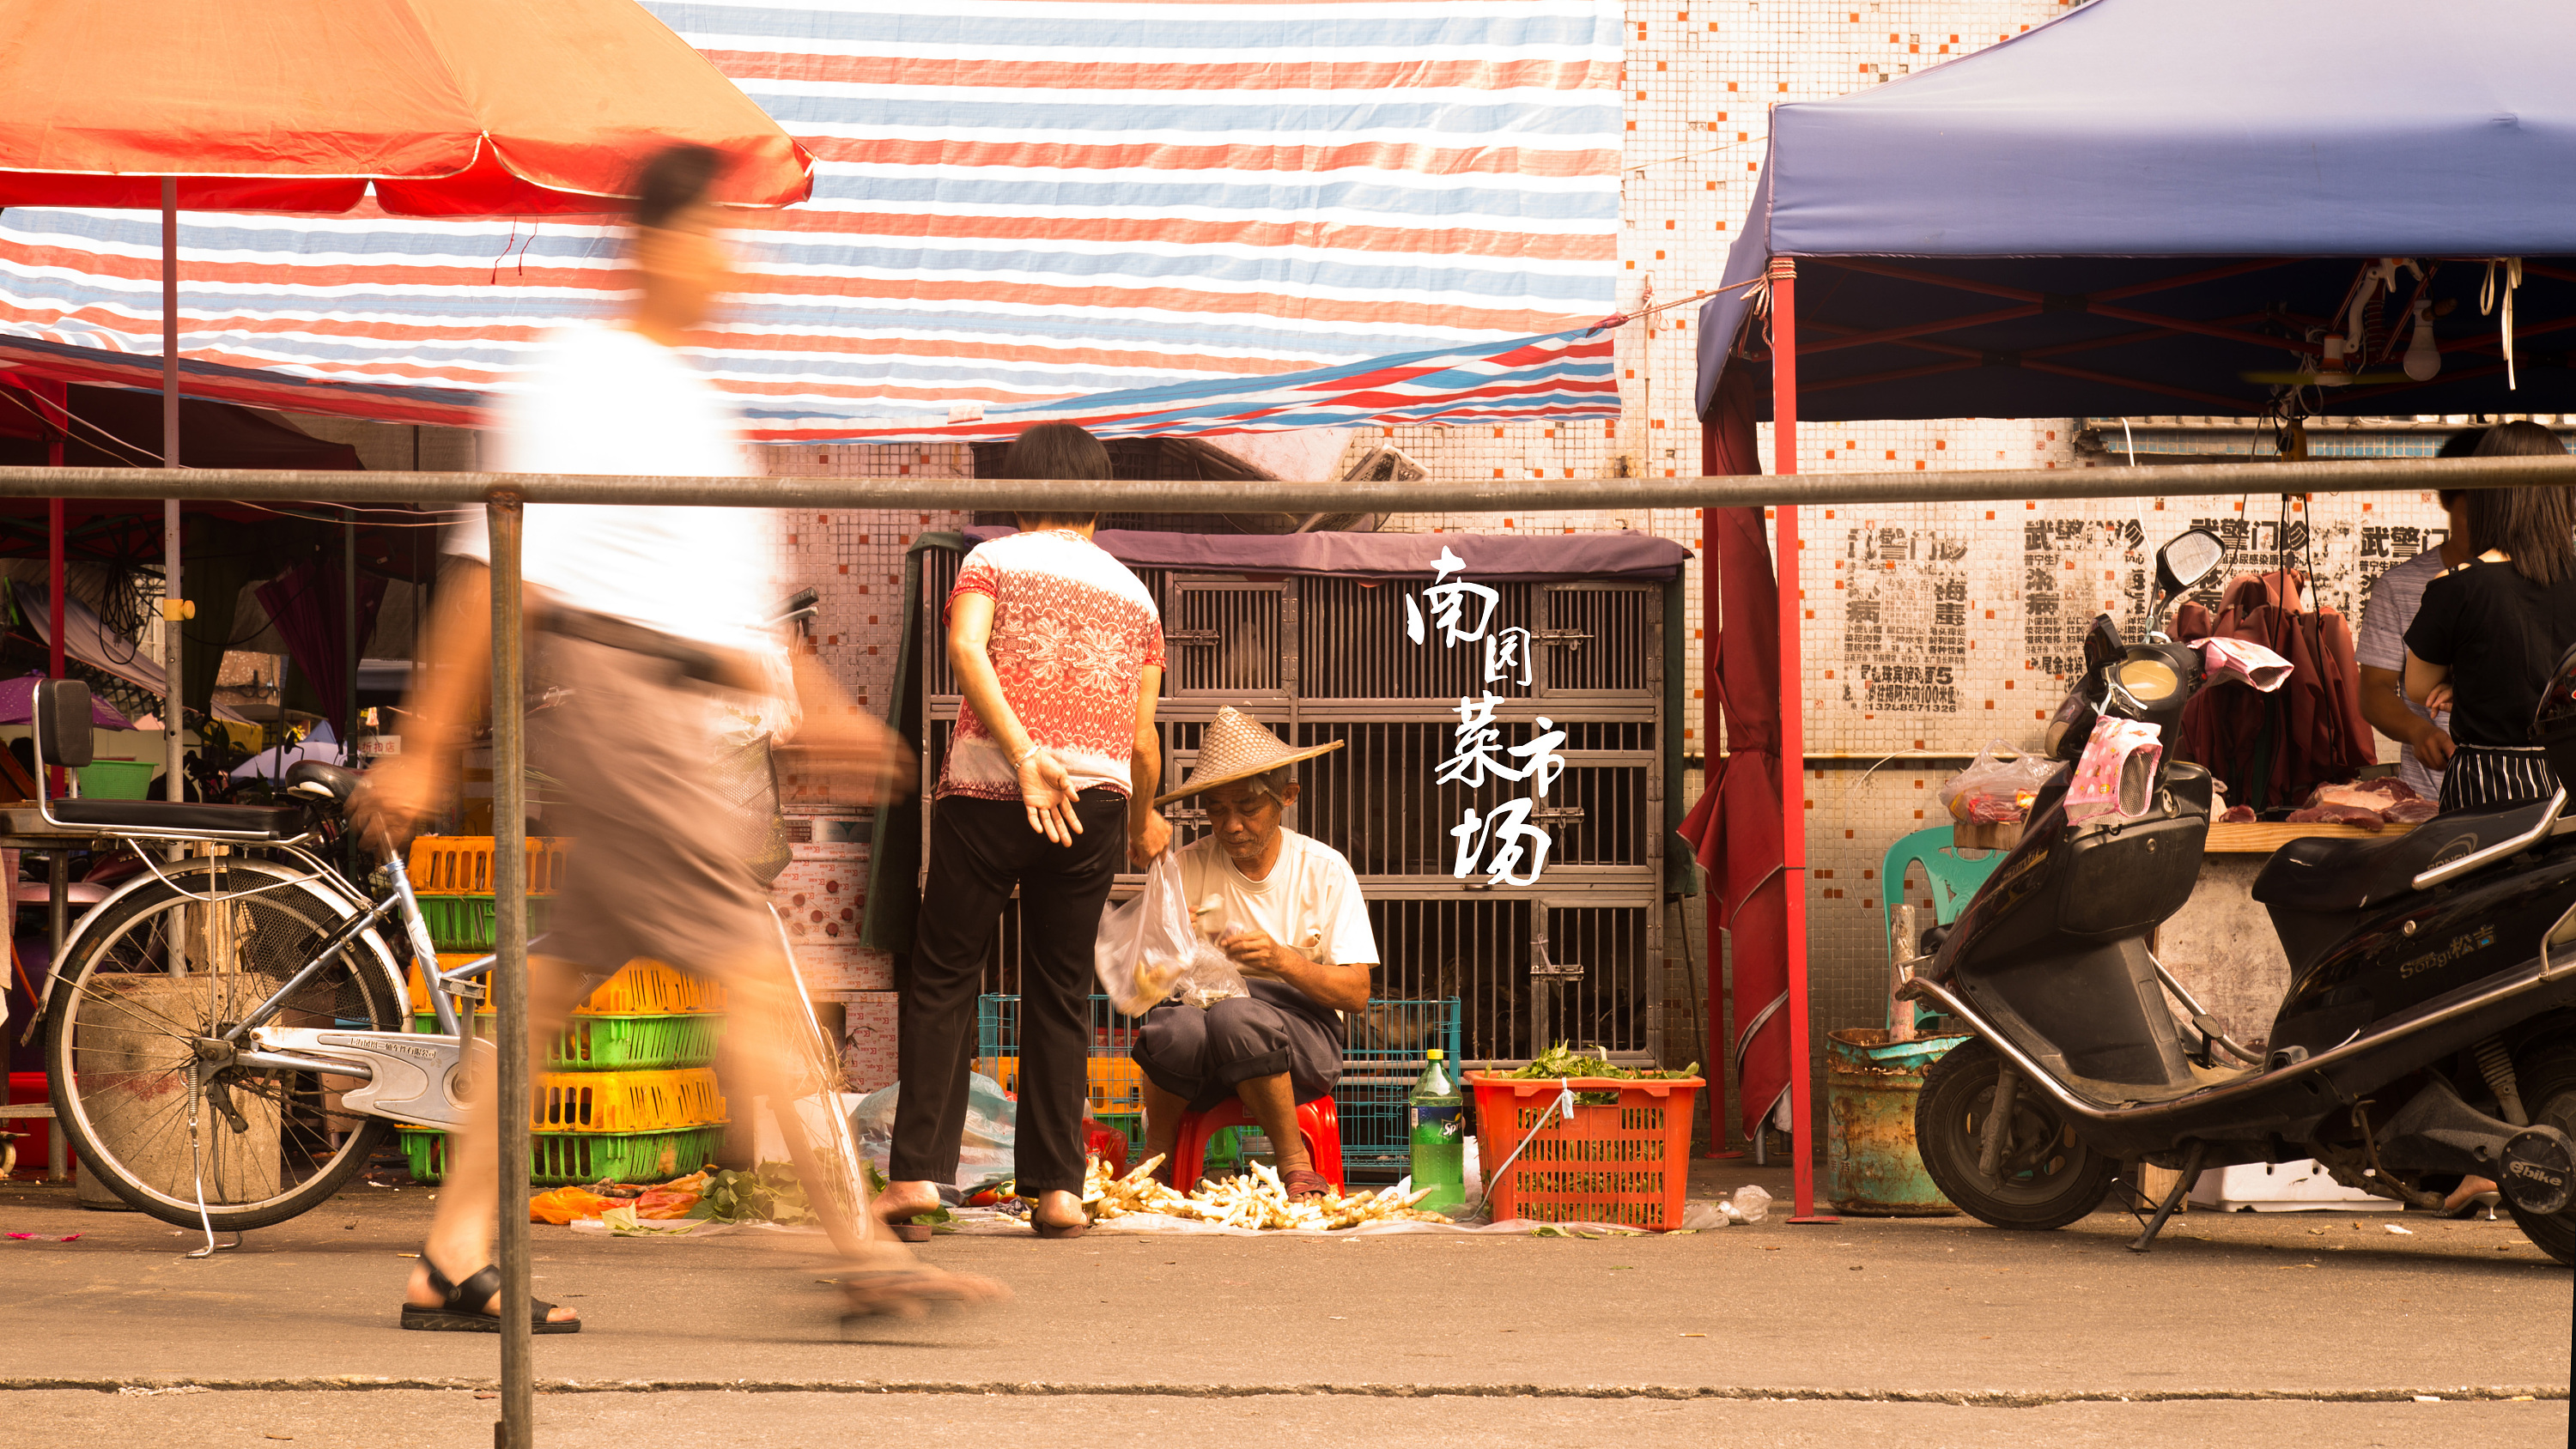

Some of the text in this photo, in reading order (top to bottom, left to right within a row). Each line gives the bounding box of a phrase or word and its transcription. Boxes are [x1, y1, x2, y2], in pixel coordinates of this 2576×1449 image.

[357, 742, 395, 753] 折扣店
[2450, 924, 2495, 960] 松吉
[2509, 1161, 2562, 1186] ebike
